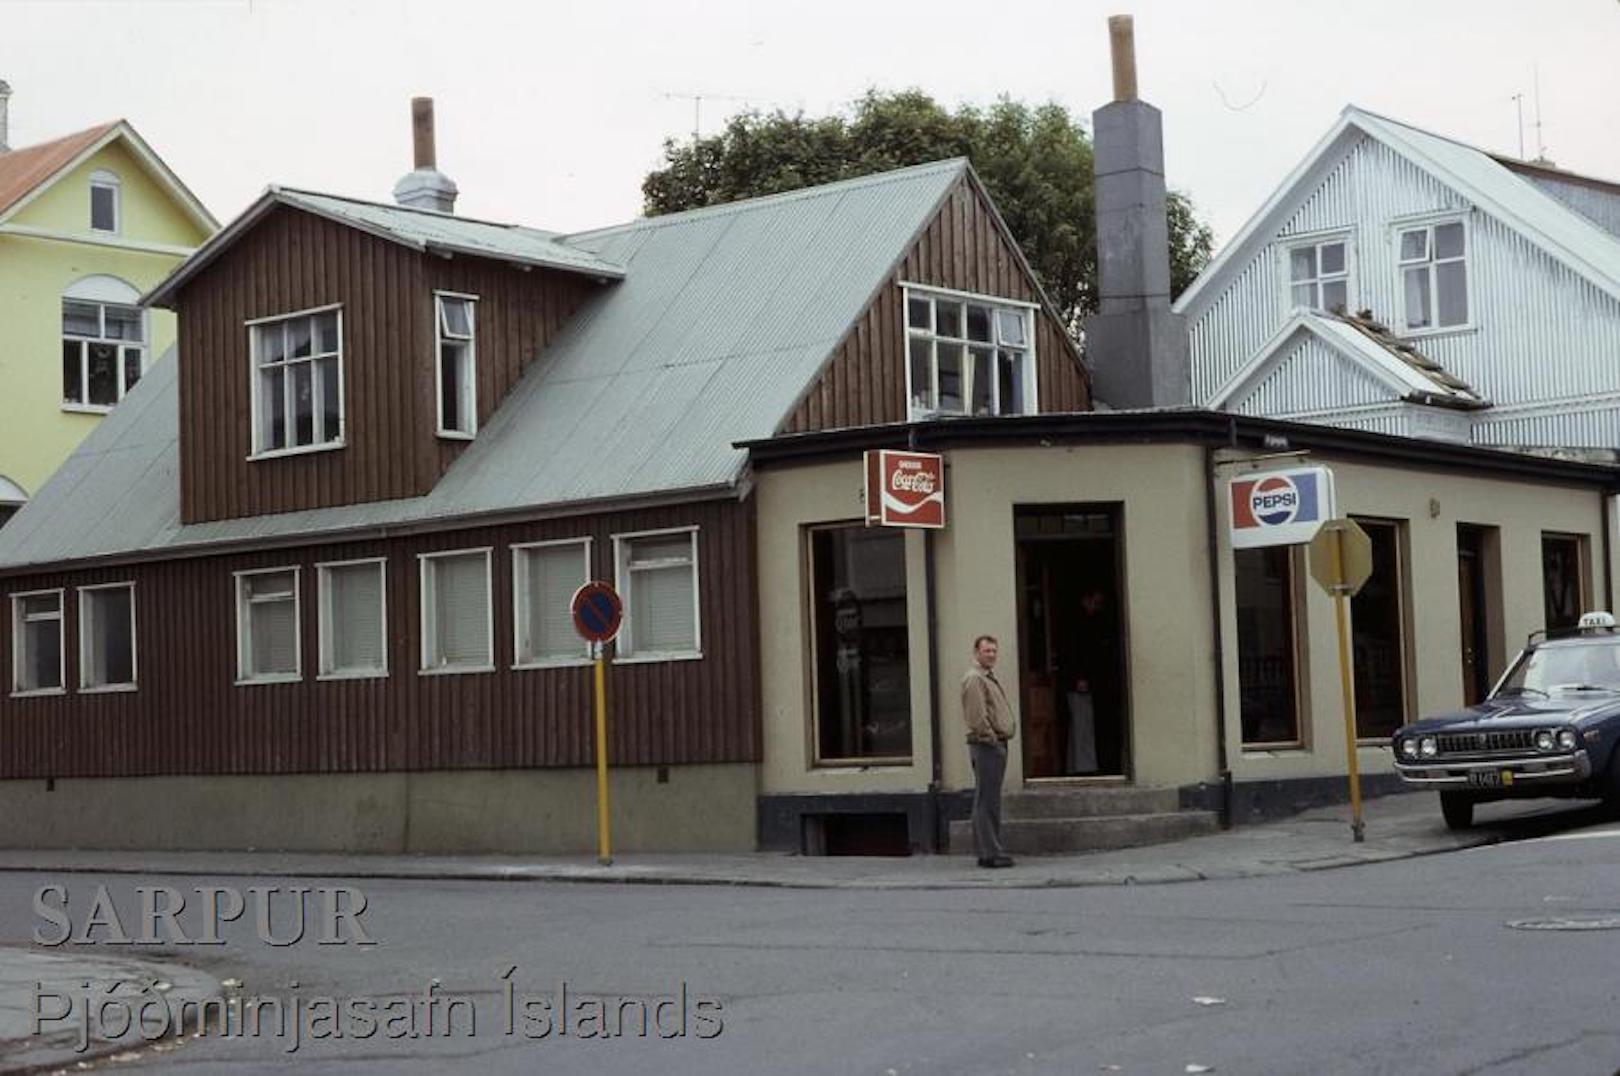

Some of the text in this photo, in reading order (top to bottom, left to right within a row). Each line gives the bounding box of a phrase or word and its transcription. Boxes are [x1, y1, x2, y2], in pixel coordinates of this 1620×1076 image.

[892, 469, 935, 493] Coca-Cola
[1253, 491, 1297, 511] PEPSI
[1584, 617, 1606, 626] TAXI
